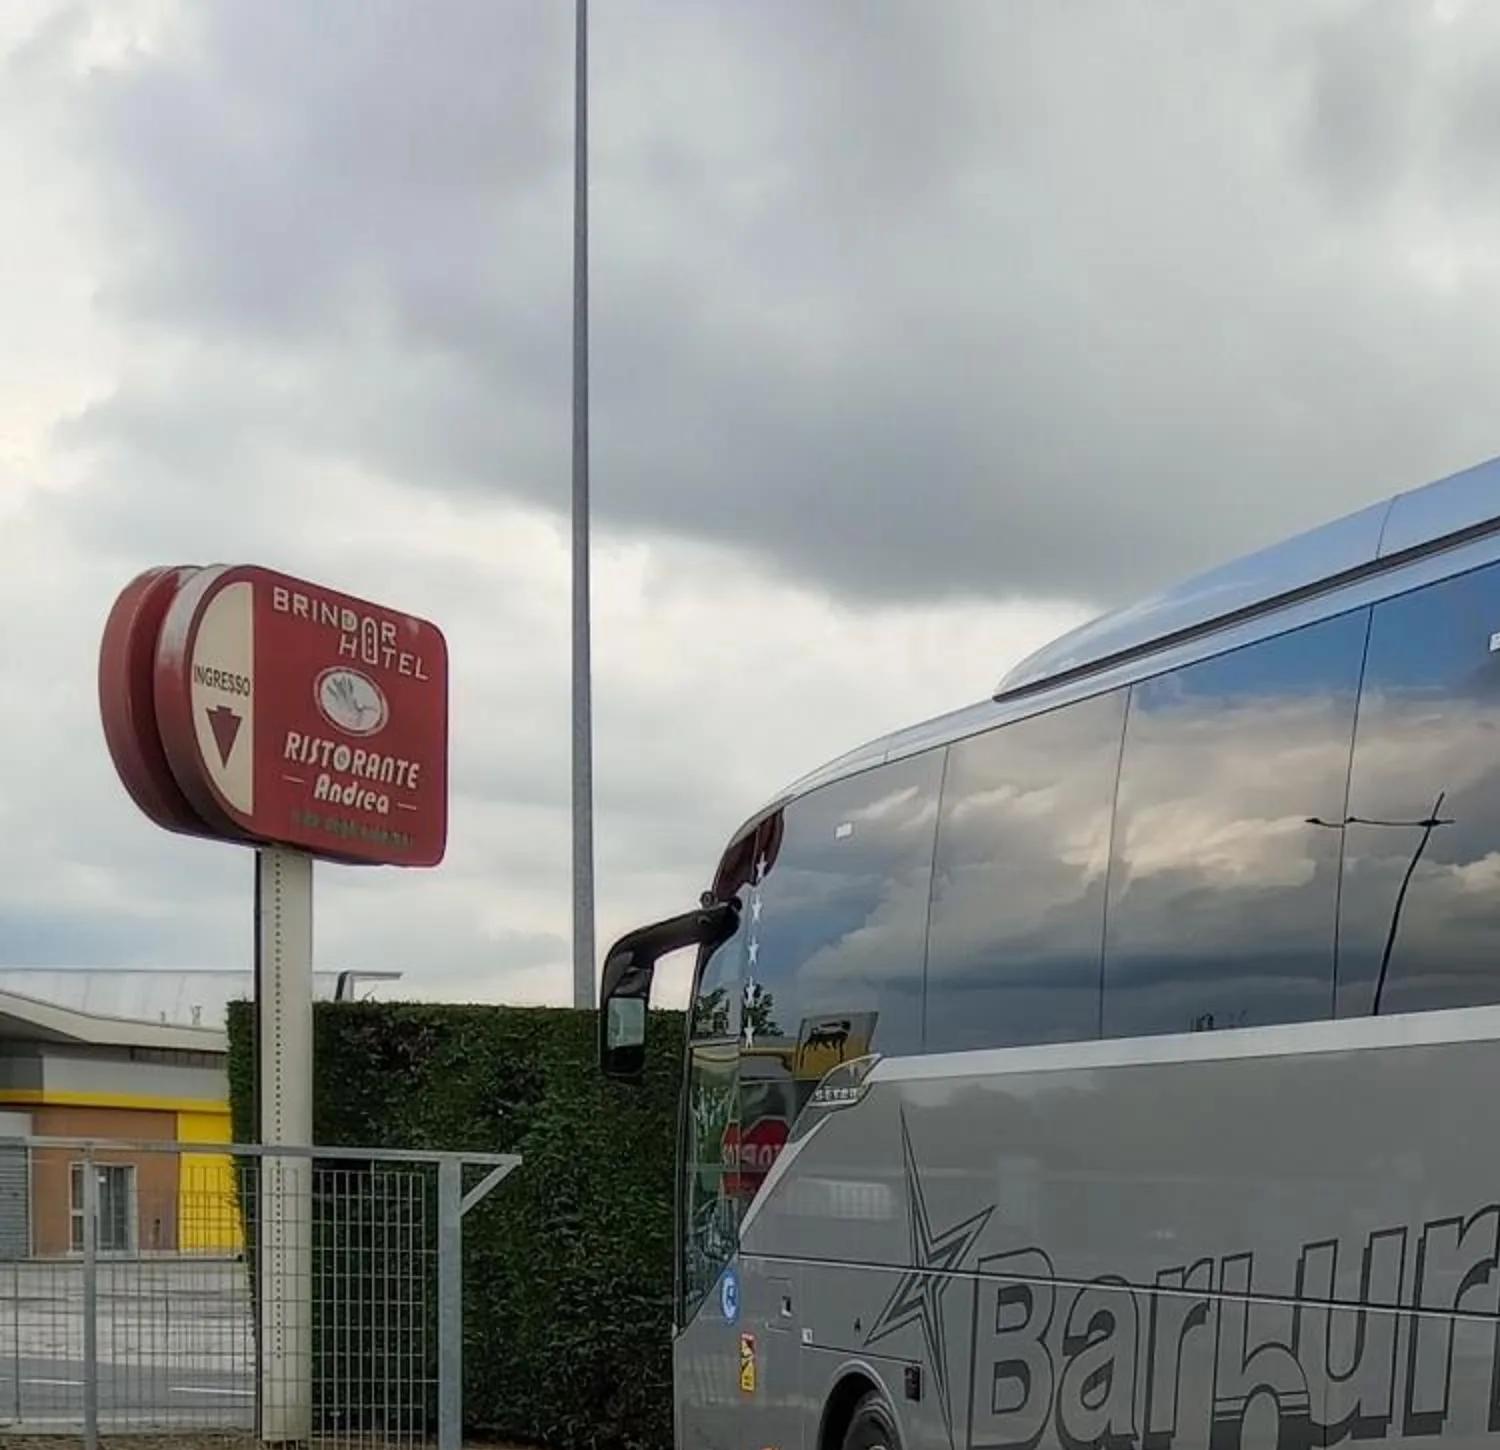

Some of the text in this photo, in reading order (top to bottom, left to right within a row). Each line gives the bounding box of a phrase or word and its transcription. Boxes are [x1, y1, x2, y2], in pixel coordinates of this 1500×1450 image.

[338, 619, 429, 680] HOTEL
[194, 664, 251, 697] INGRESSO
[284, 731, 420, 789] RISTORANTE
[314, 773, 390, 815] Andrea
